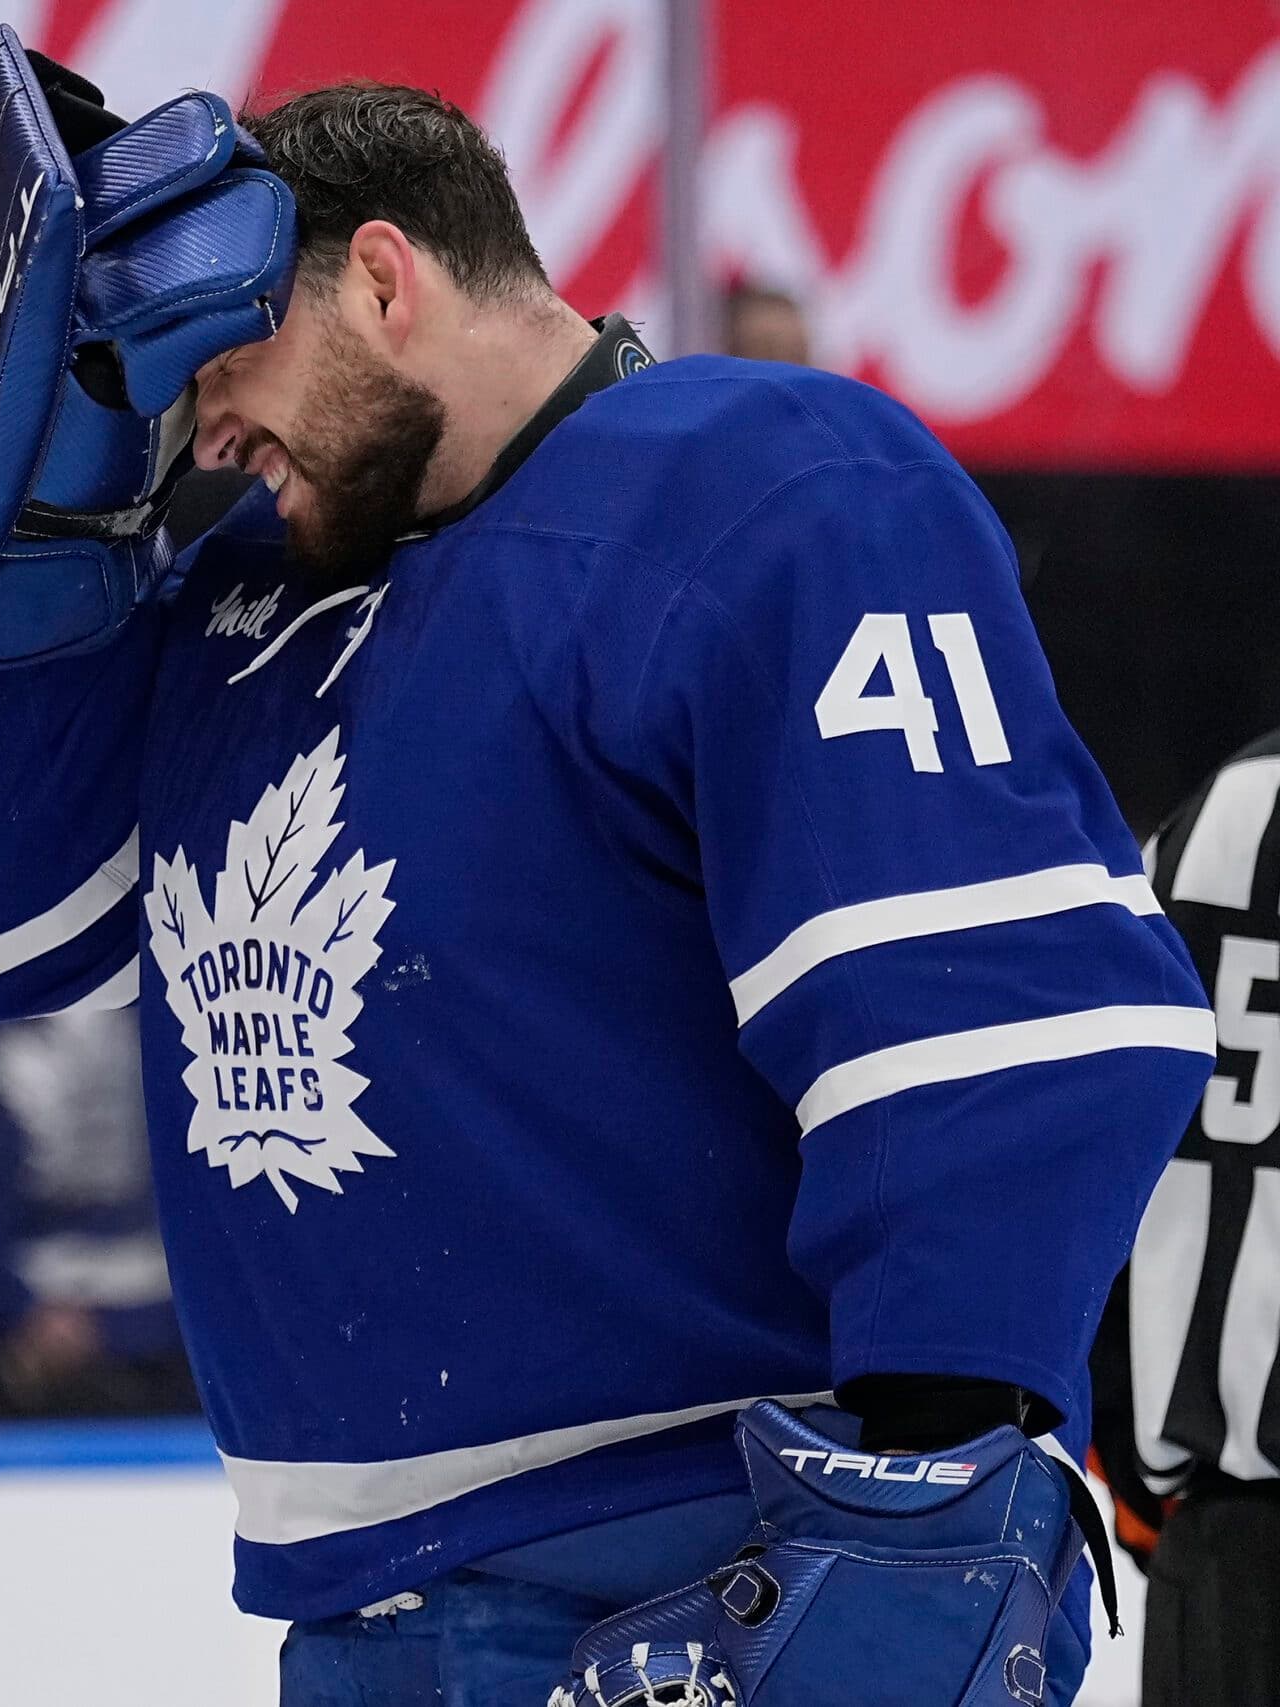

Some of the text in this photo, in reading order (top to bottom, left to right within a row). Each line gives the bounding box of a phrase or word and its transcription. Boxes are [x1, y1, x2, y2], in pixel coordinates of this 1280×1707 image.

[205, 582, 286, 640] Milk
[814, 613, 1012, 773] 41
[181, 939, 334, 1020] TORONTO
[207, 1010, 315, 1057] MAPLE
[214, 1065, 324, 1111] LEAFS
[779, 1448, 978, 1485] TRUE
